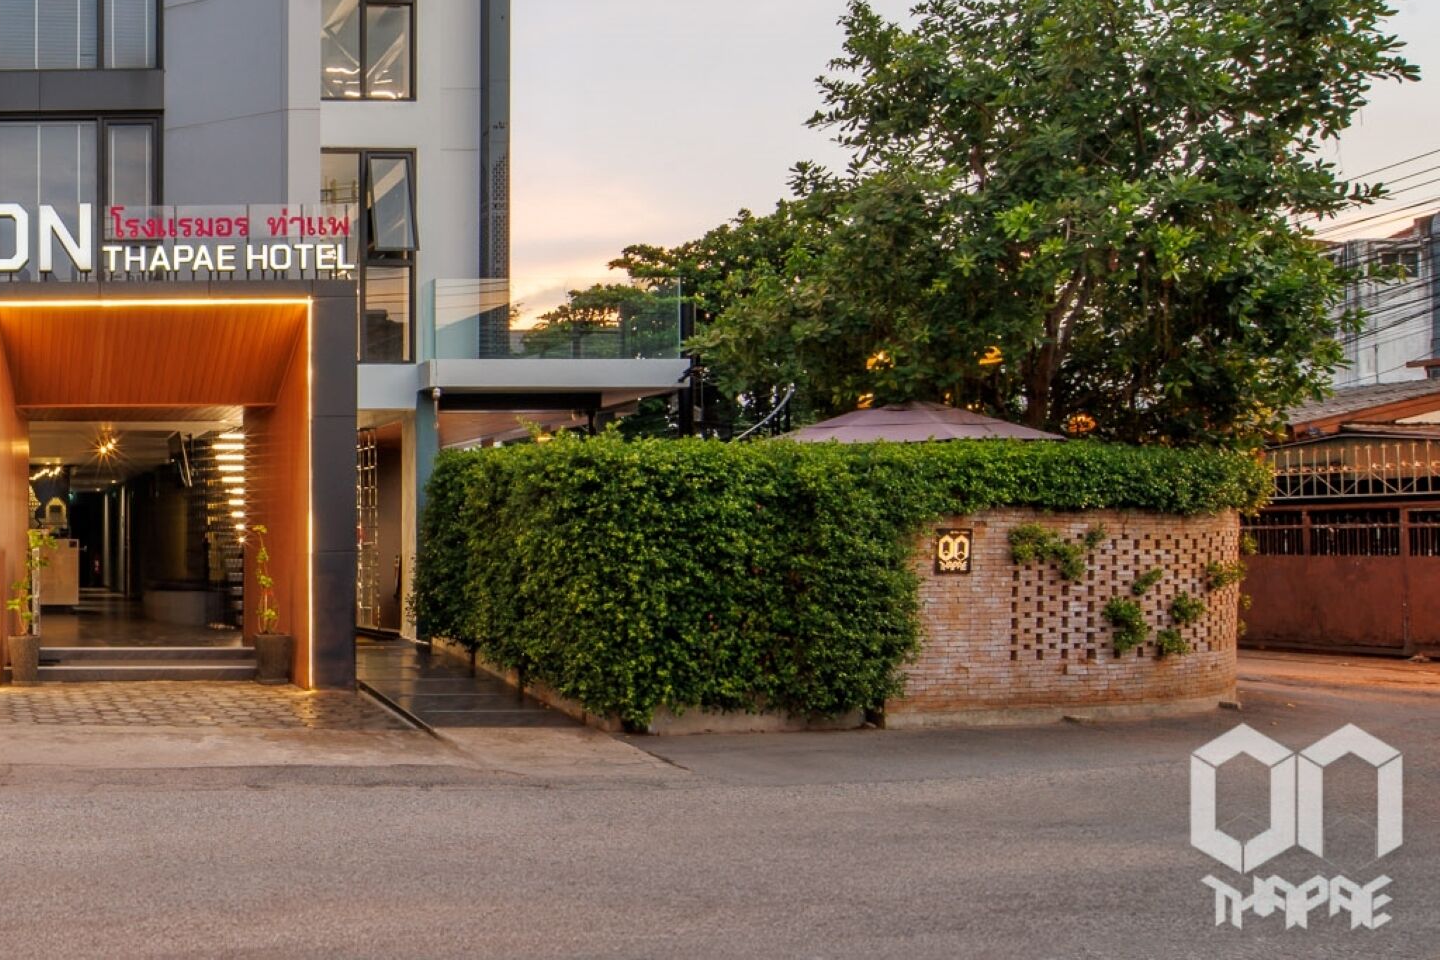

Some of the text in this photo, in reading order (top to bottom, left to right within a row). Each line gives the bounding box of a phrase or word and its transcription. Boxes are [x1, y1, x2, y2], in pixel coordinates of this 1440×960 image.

[266, 208, 350, 237] ท่าแพ
[102, 243, 356, 272] THAPAE HOTEL
